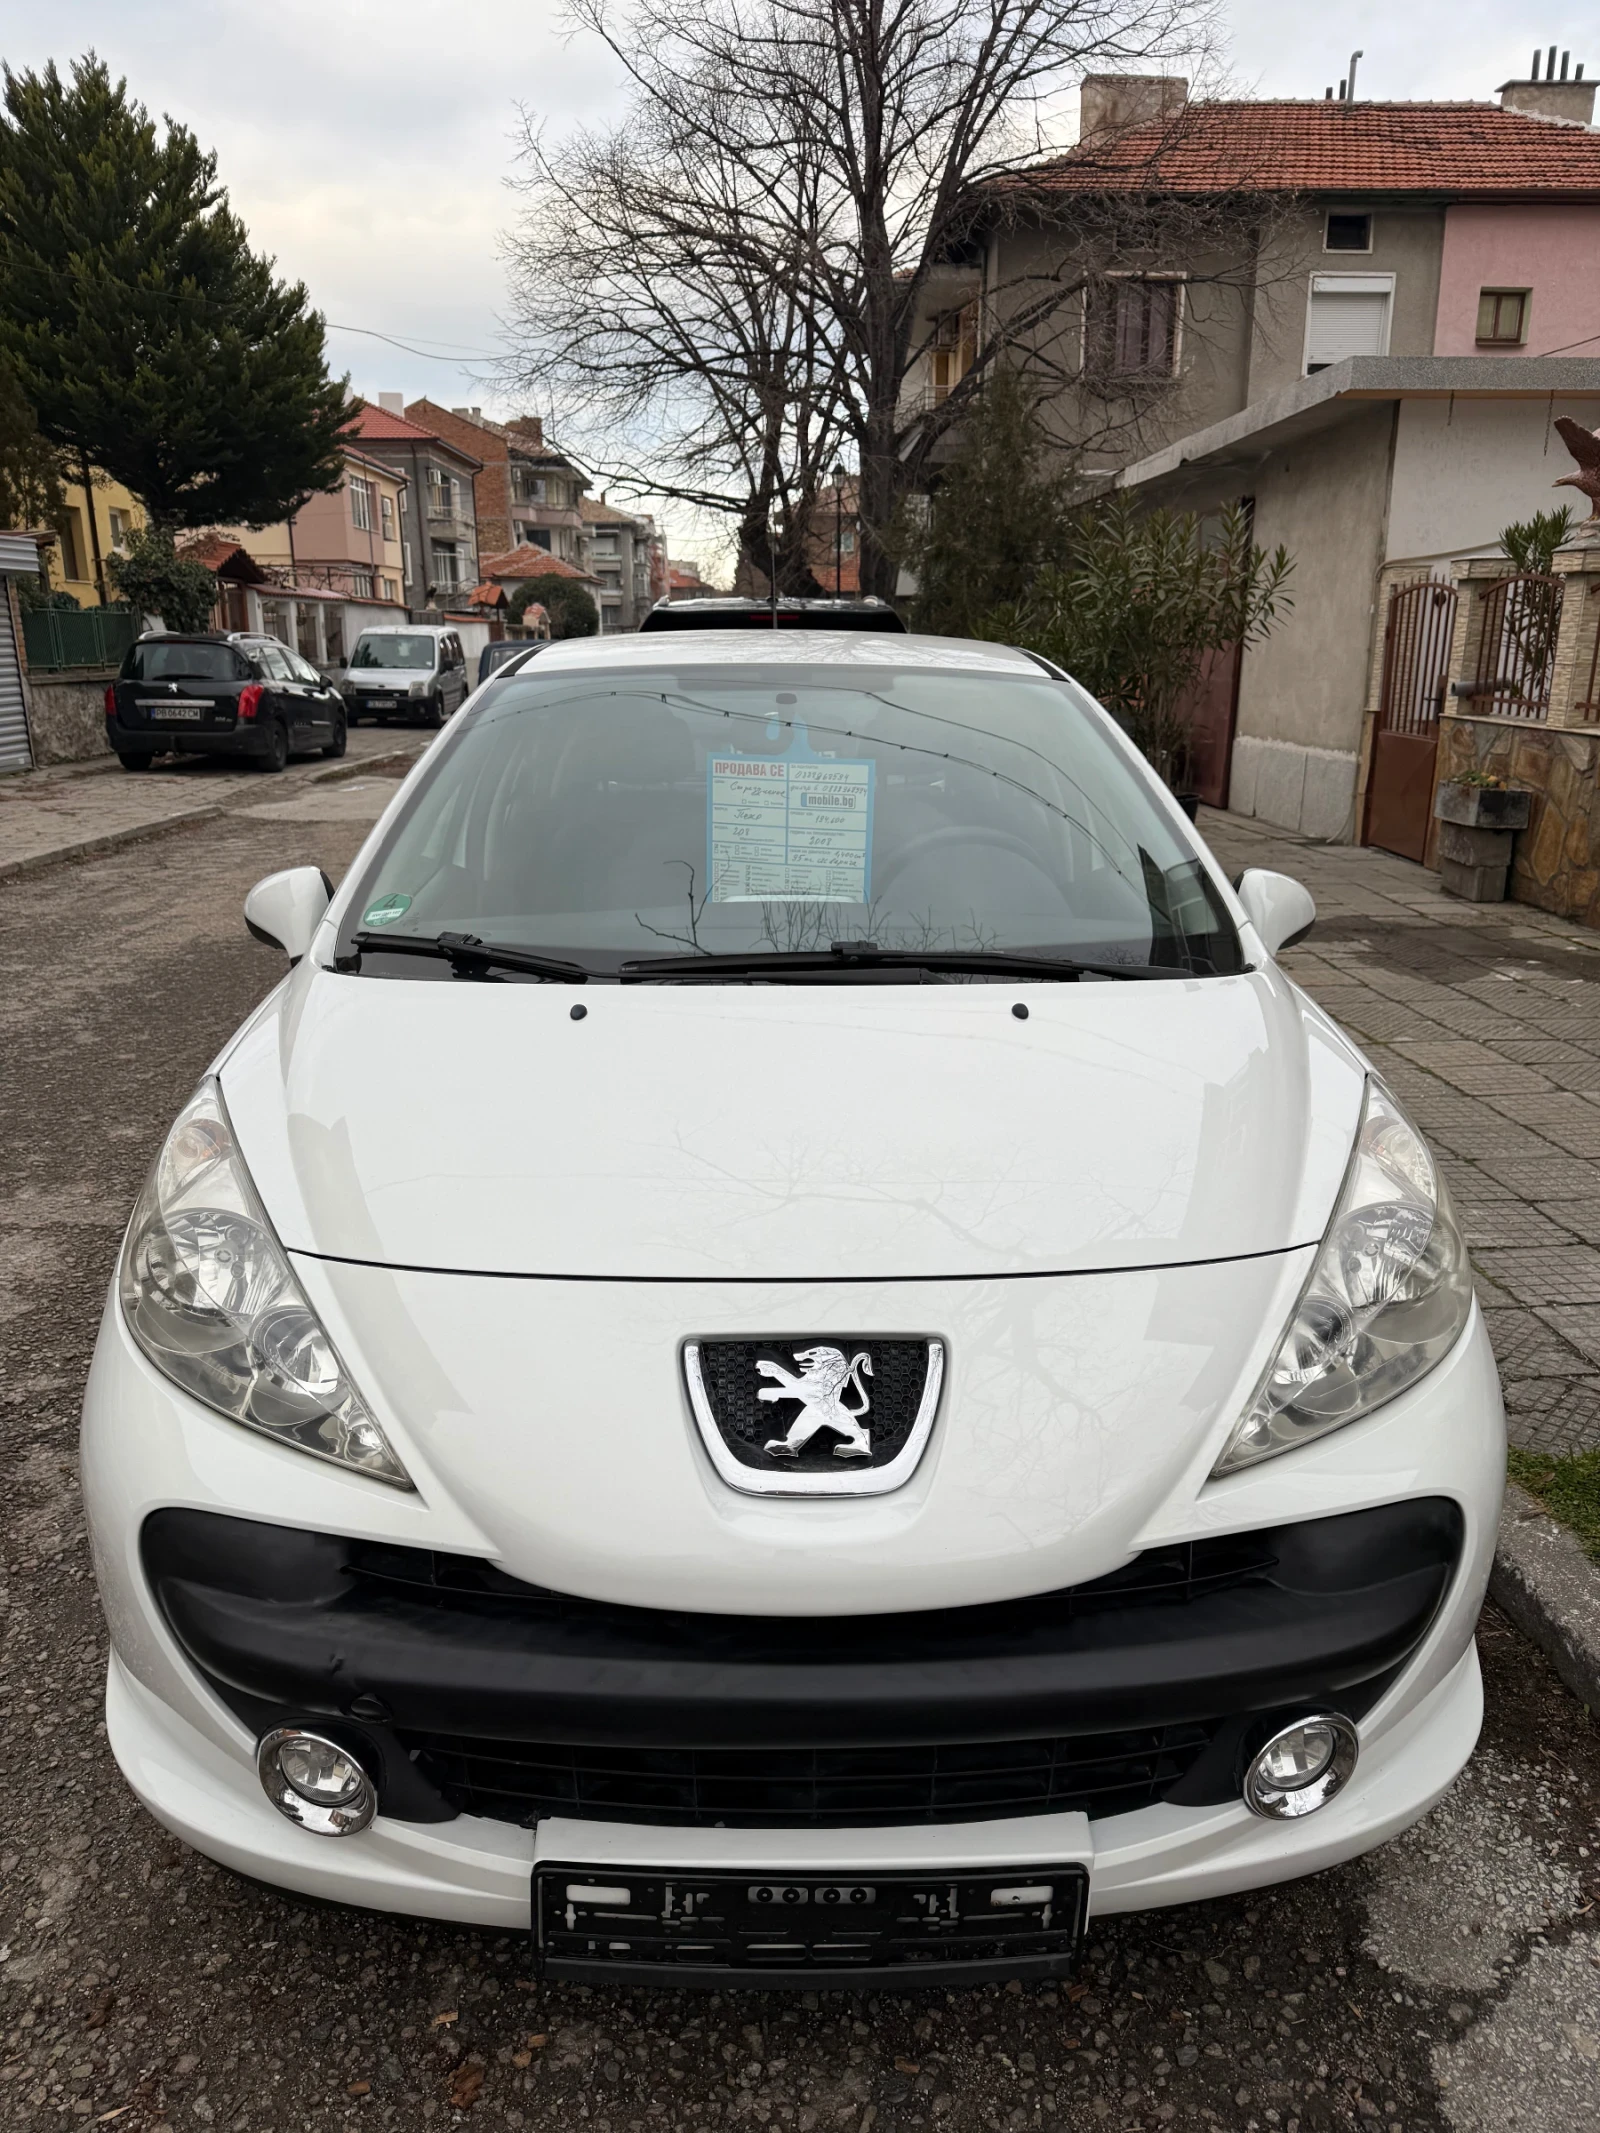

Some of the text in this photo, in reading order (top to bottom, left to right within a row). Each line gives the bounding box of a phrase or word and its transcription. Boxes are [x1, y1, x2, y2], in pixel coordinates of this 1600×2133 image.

[715, 762, 785, 777] ПРОДАВА СЕ
[808, 795, 854, 808] mobile.bg
[383, 894, 399, 909] 4
